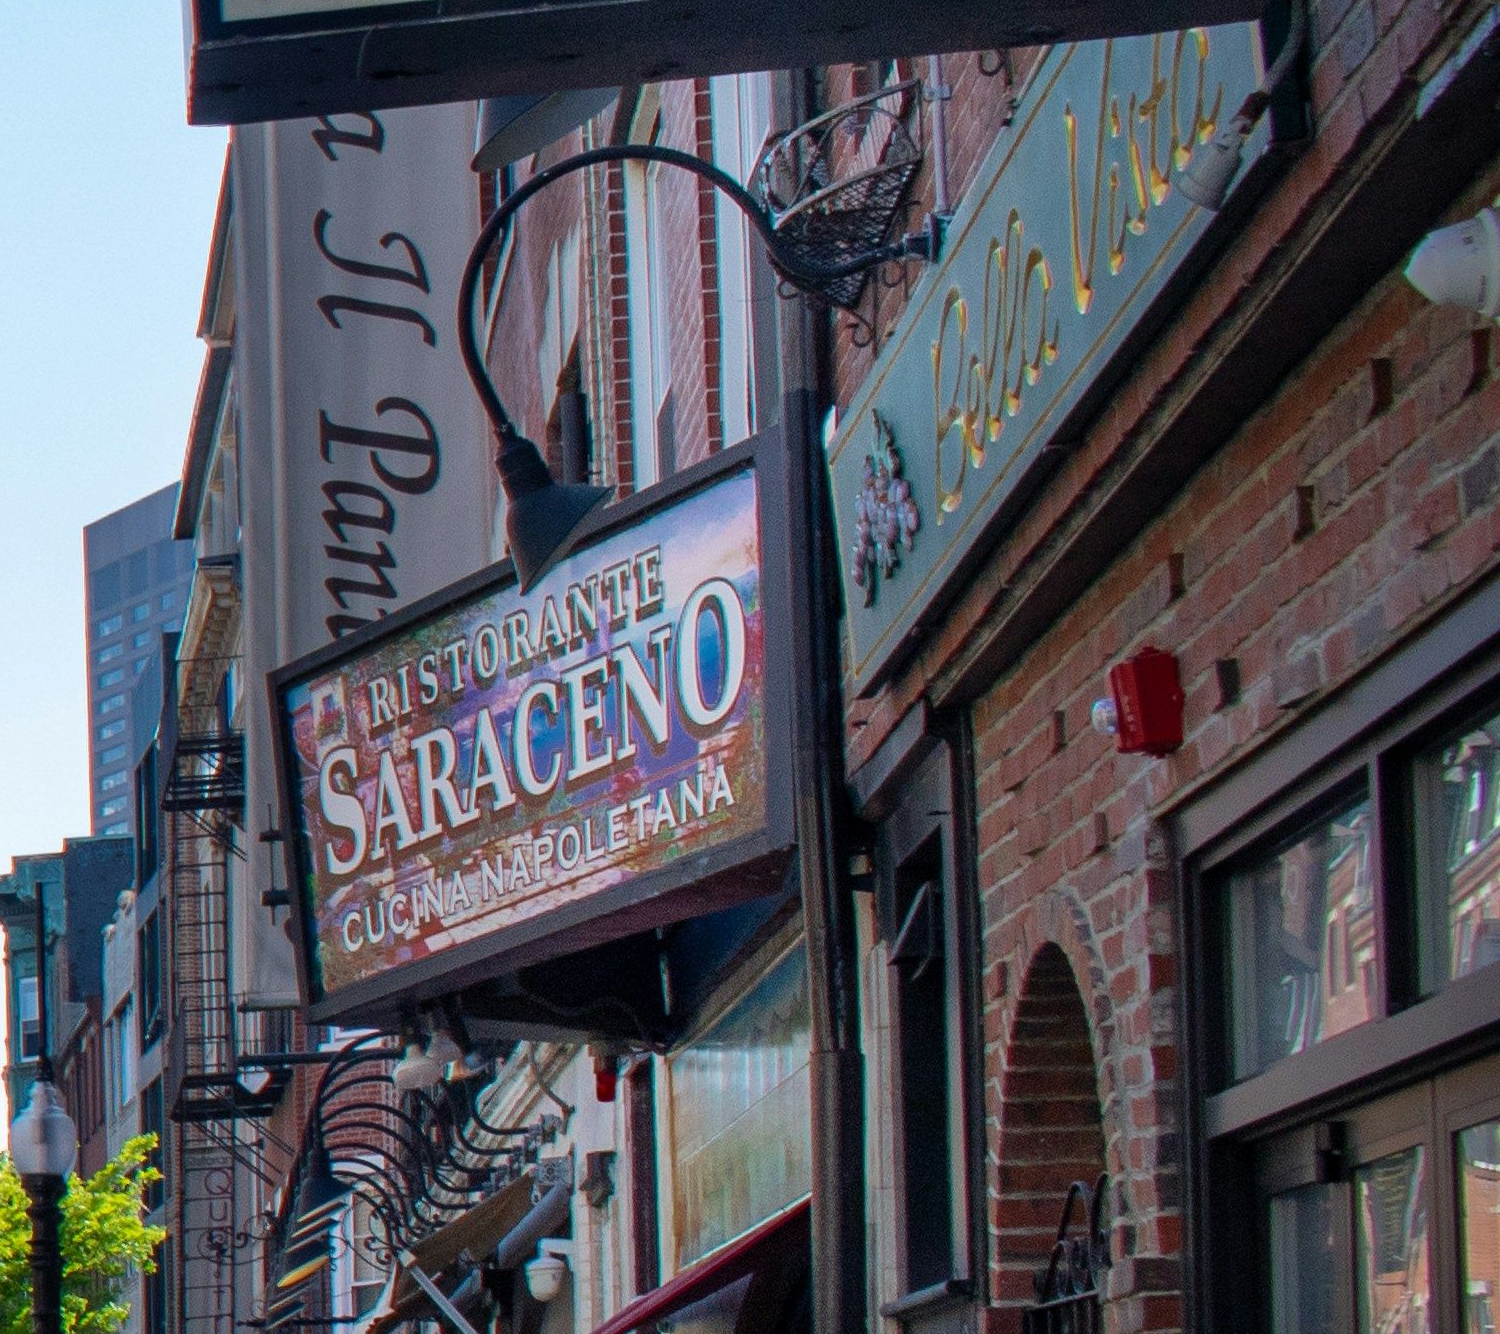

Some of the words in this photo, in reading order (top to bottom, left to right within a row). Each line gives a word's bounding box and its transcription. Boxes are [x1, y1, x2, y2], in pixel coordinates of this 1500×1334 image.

[930, 207, 1059, 525] Bella
[319, 579, 747, 879] SARACENO
[368, 545, 666, 739] RISTORANTE
[340, 875, 473, 955] CUCINA
[481, 762, 735, 907] NAPOLETANA
